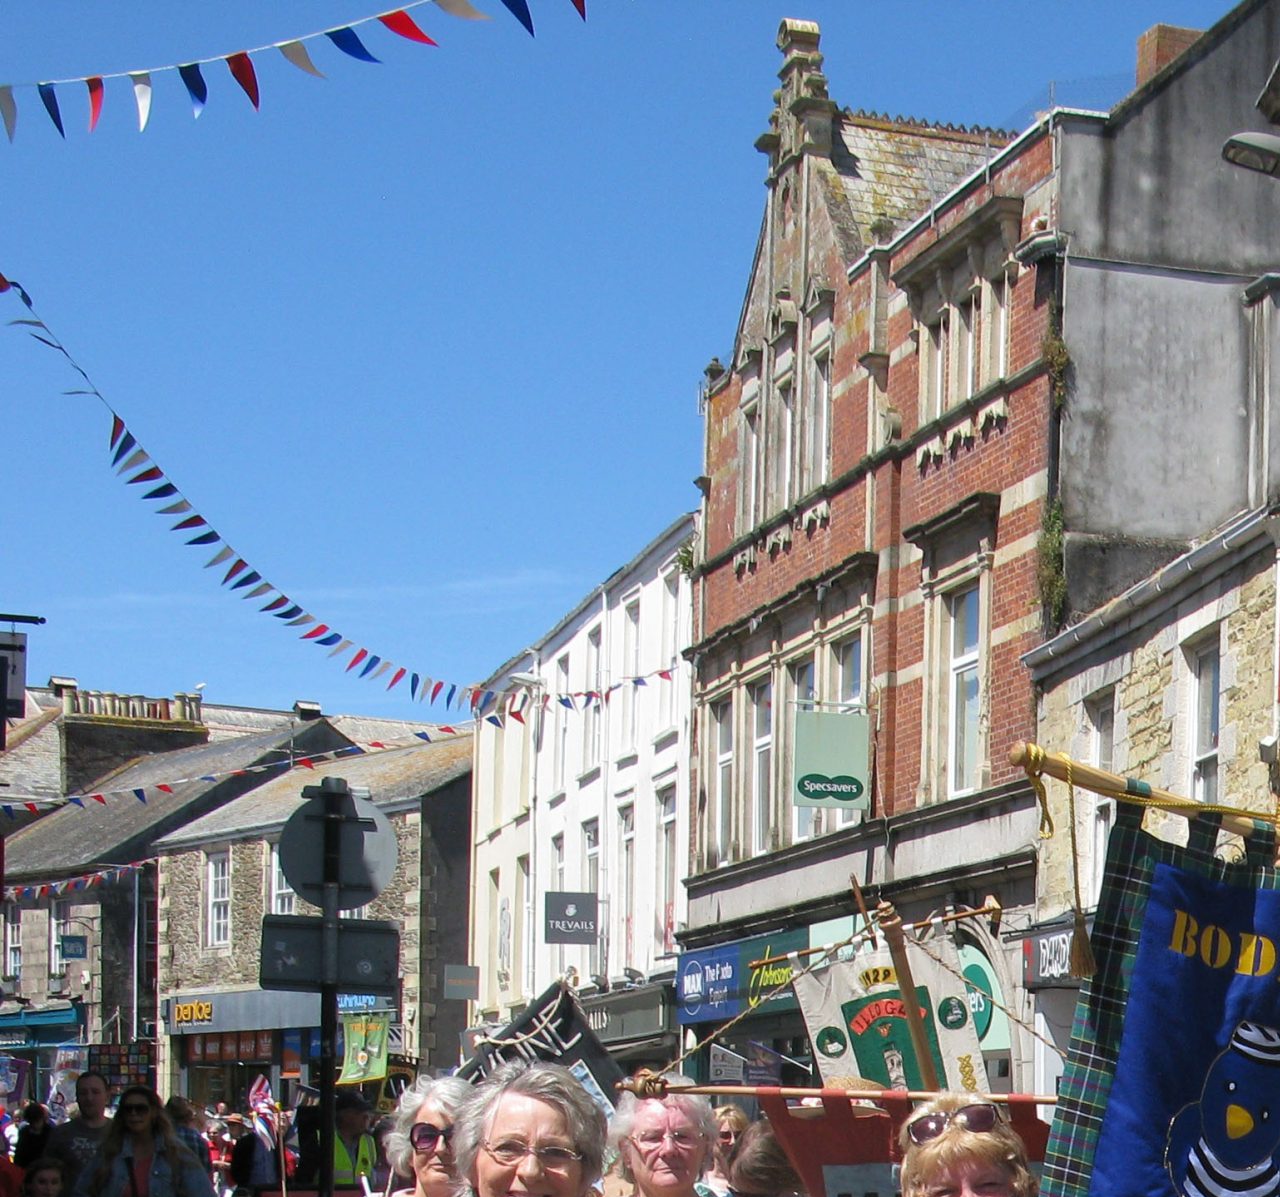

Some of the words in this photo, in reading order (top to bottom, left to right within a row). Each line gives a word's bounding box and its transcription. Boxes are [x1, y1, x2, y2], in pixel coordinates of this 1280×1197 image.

[803, 780, 857, 793] Specsavers
[549, 919, 595, 933] TREVAILS
[683, 972, 702, 995] MAX
[588, 1009, 608, 1031] AILS
